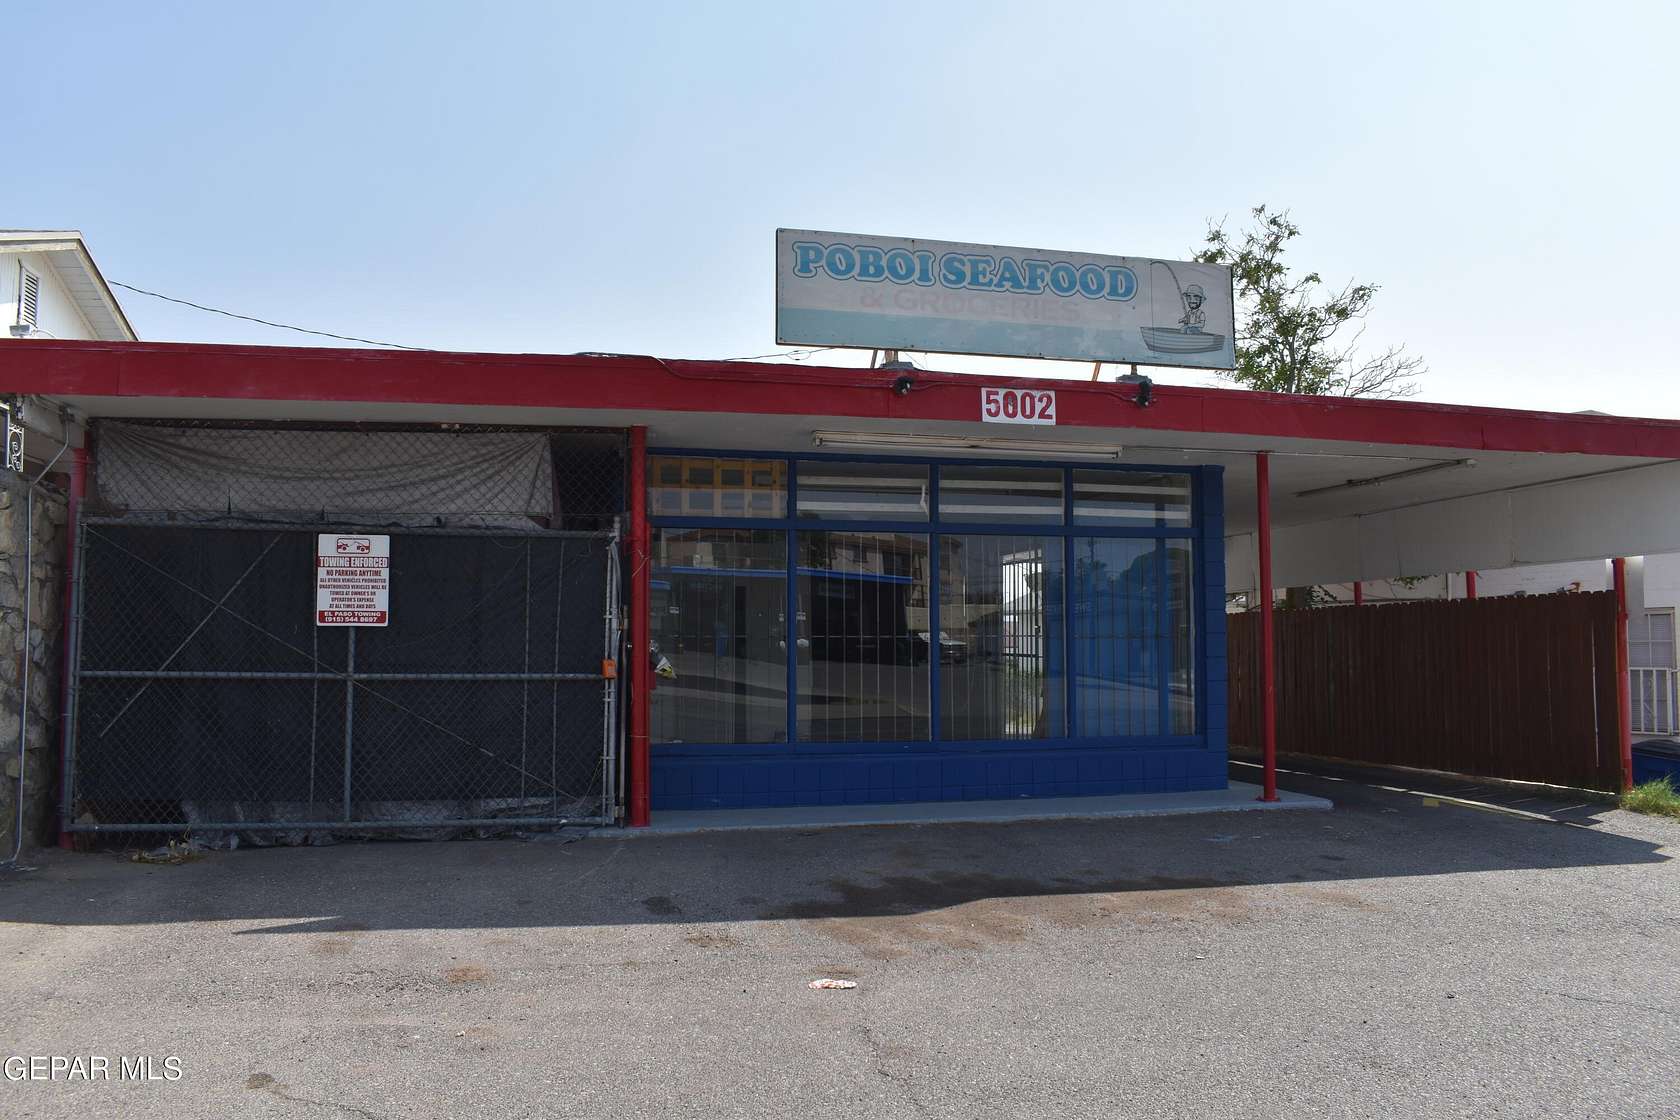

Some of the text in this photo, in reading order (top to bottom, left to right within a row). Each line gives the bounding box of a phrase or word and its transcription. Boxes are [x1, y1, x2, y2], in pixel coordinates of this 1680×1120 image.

[793, 242, 1138, 301] POBOI SEAFOOD
[860, 287, 1082, 323] & GROCERIES
[985, 390, 1053, 419] 5002
[320, 556, 388, 567] TOWING ENFORCED
